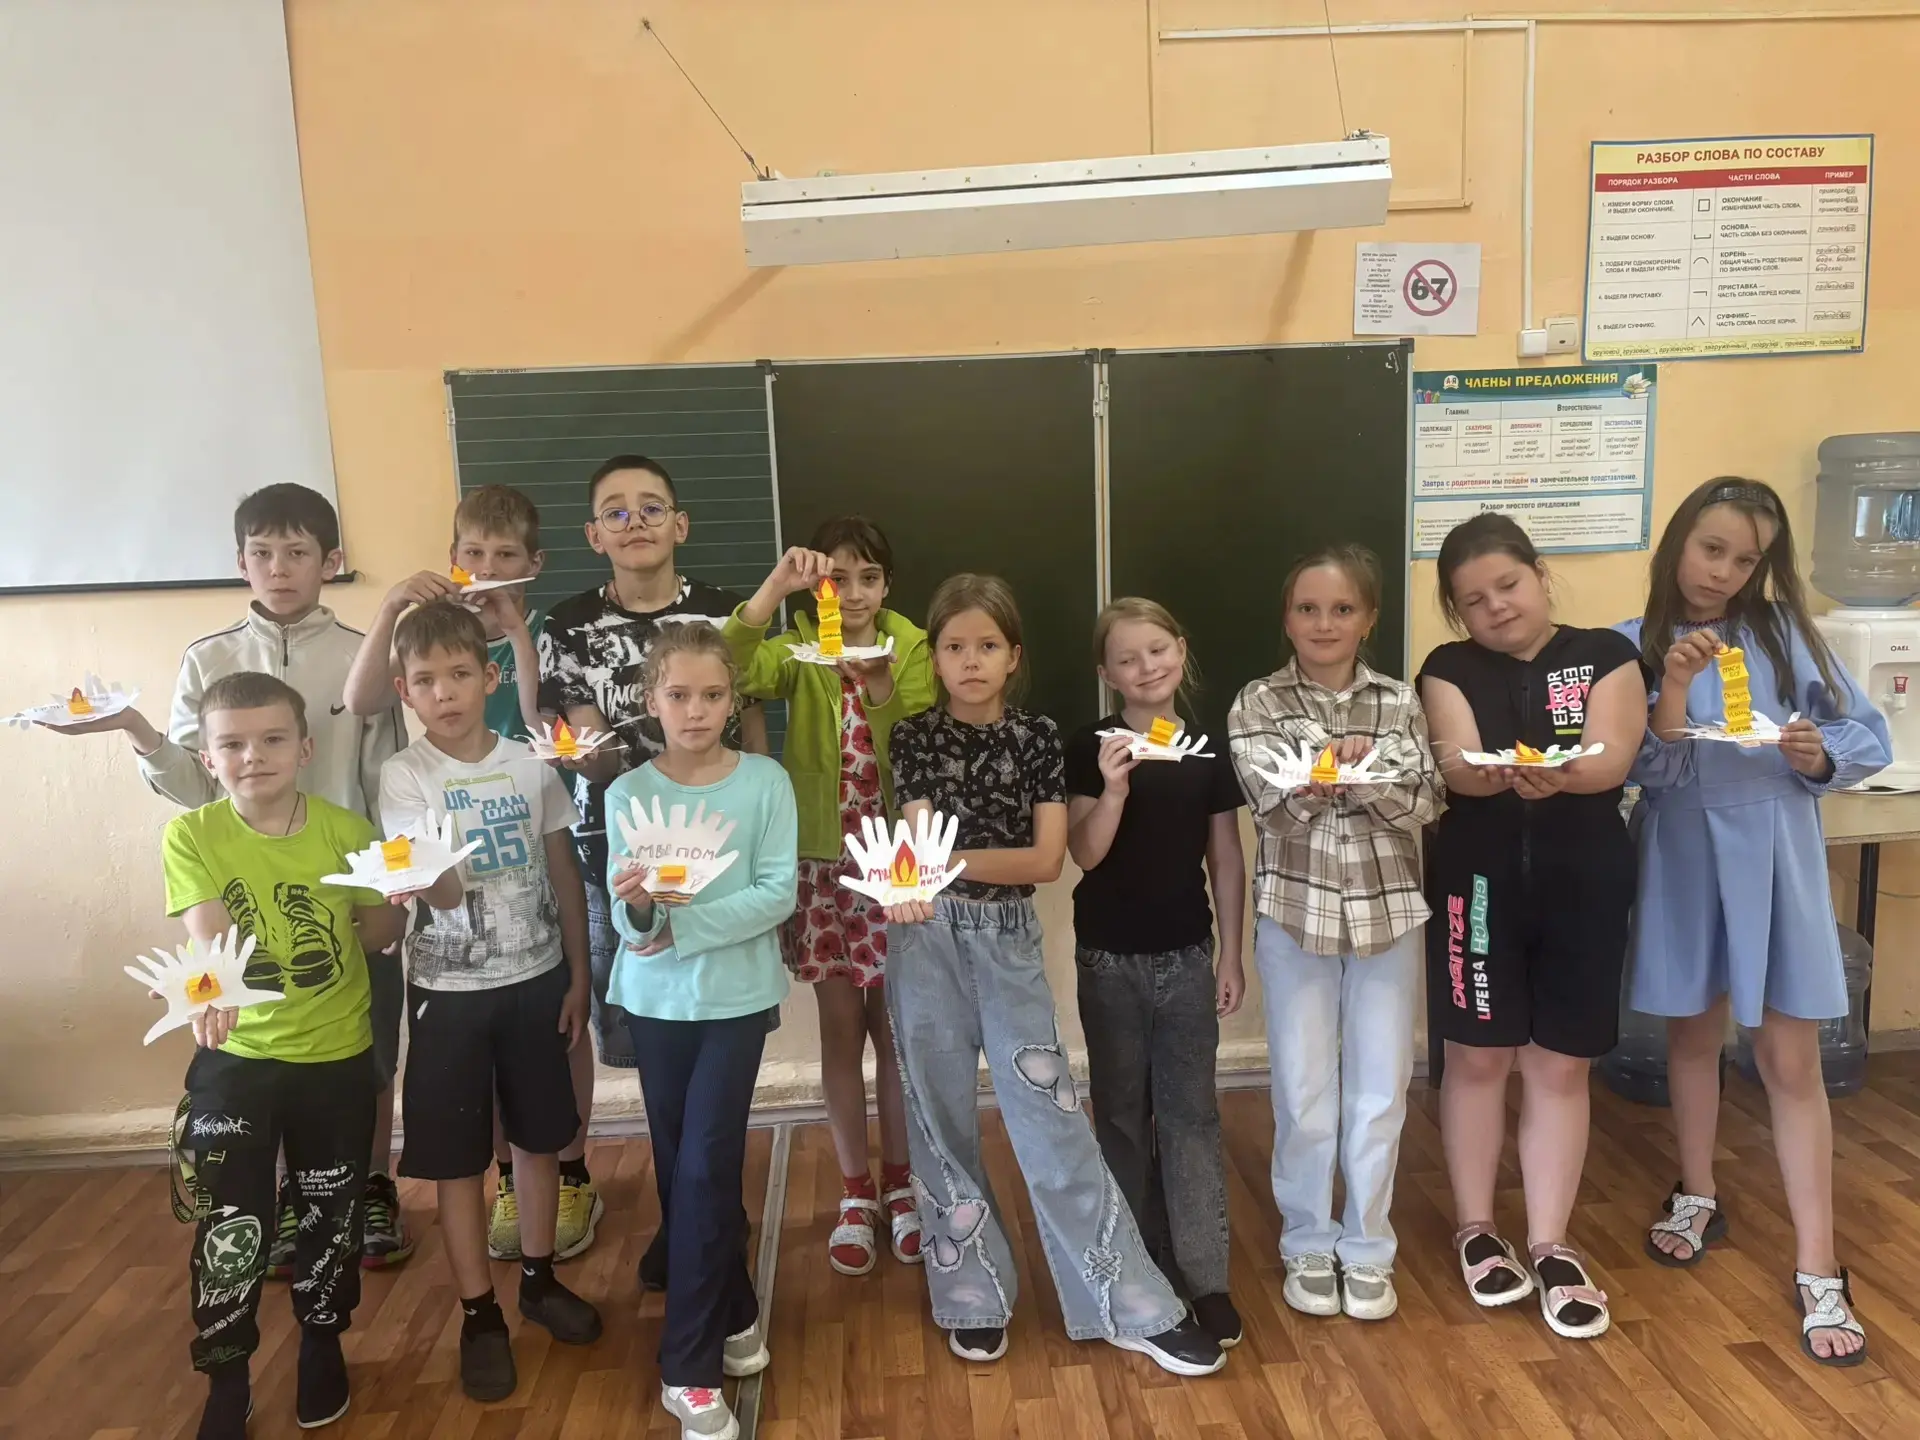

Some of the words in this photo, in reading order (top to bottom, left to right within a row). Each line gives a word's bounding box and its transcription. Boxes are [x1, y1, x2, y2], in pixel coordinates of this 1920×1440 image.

[1636, 151, 1691, 164] РАЗБОР
[1694, 149, 1740, 161] СЛОВА
[1744, 148, 1762, 159] ПО
[1766, 147, 1825, 158] СОСТАВУ
[1608, 178, 1642, 186] ПОРЯДОК
[1643, 176, 1679, 185] РАЗБОРА
[1825, 171, 1854, 179] ПРИМЕР
[1722, 196, 1763, 204] ОКОНЧАНИЕ
[1465, 377, 1511, 388] ЧЛЕНЫ
[1515, 373, 1618, 387] ПРЕДЛОЖЕНИЯ
[1422, 480, 1444, 488] Завтра
[1451, 479, 1490, 488] родителями
[465, 823, 528, 873] 95
[635, 844, 672, 859] МЫ
[675, 846, 716, 860] ПОМ
[1448, 894, 1467, 1009] DIGITIZE
[1473, 961, 1485, 971] A
[1476, 989, 1491, 1020] LIFE
